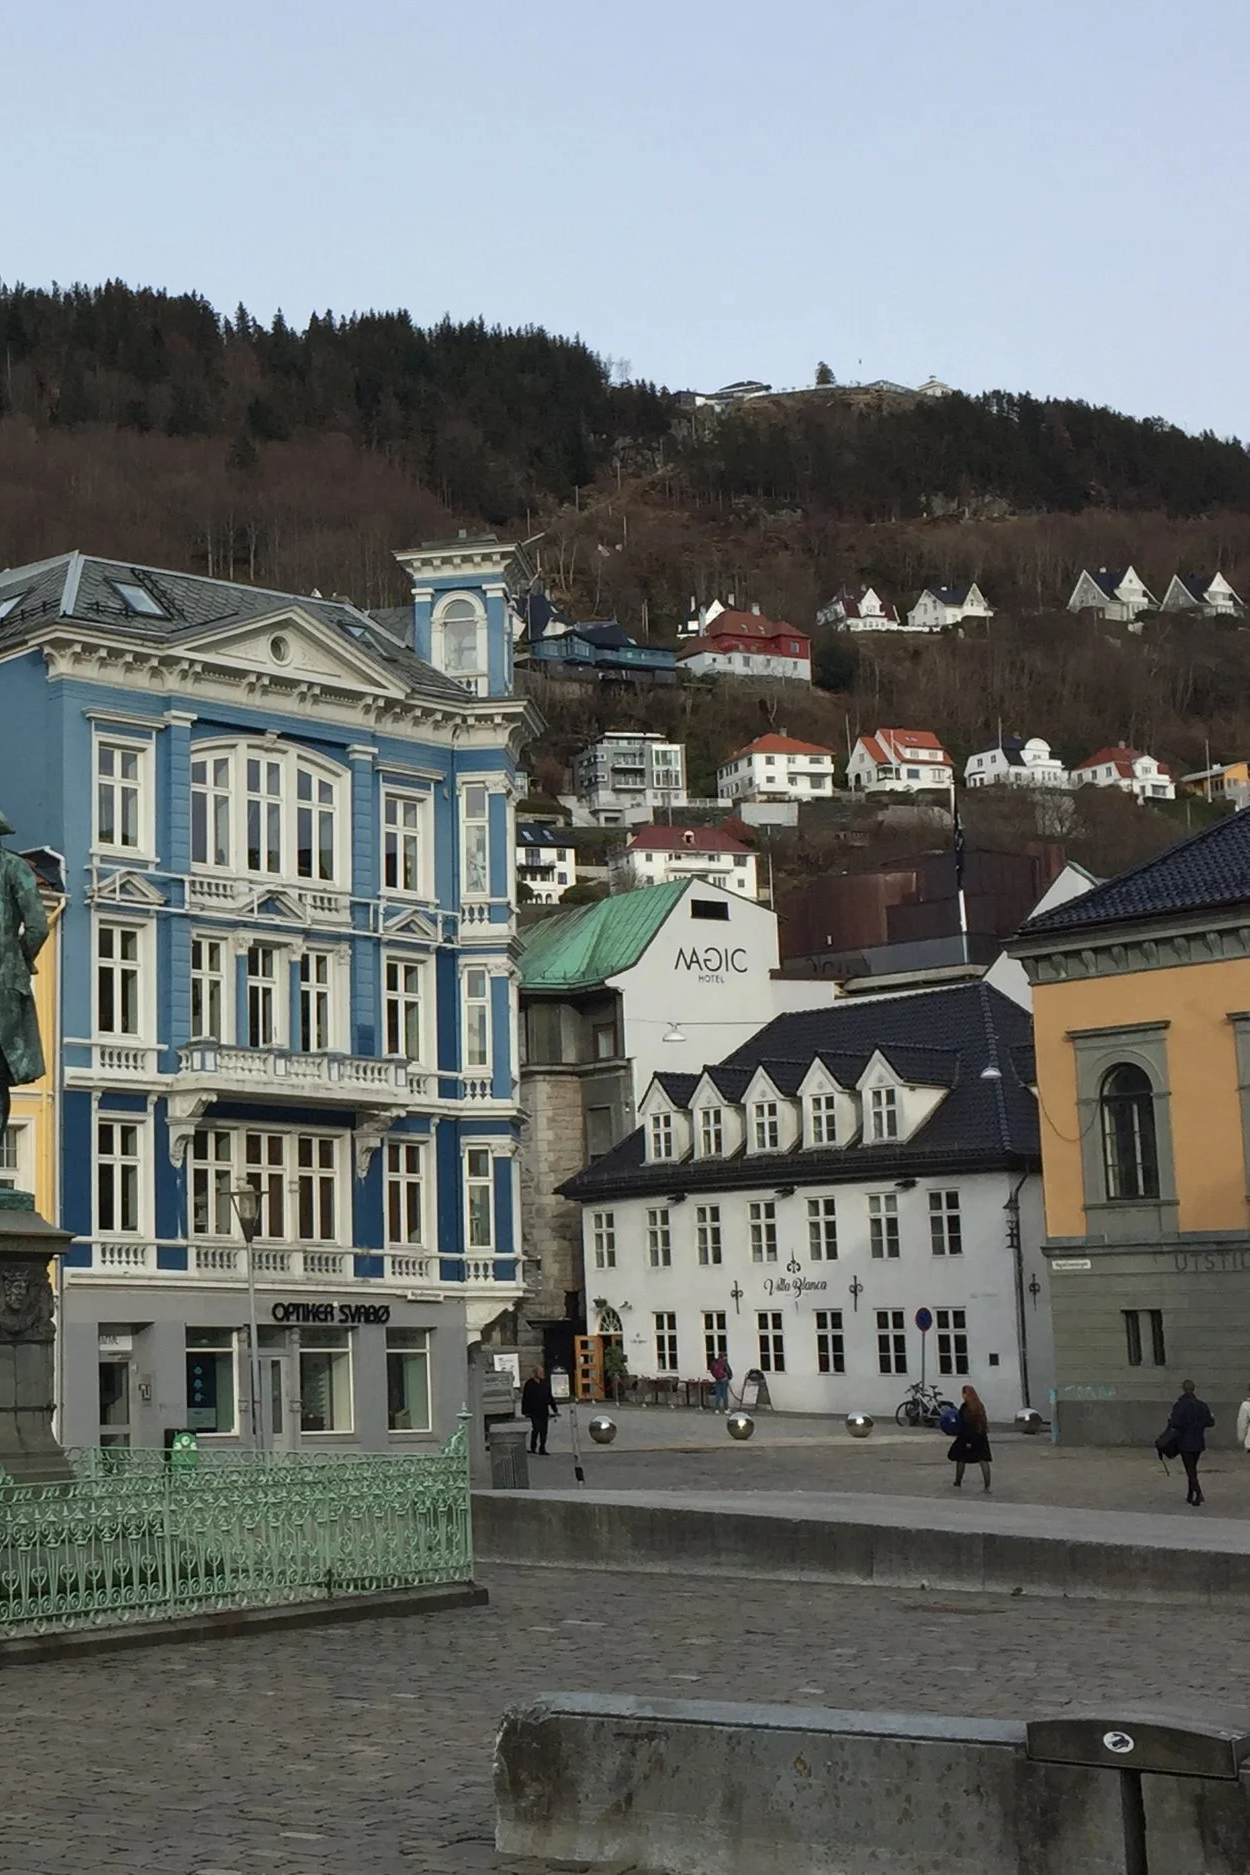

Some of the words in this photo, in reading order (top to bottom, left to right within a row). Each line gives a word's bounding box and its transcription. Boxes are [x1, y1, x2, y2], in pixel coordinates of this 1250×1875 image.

[674, 946, 748, 973] MAGIC
[698, 974, 725, 984] HOTEL
[763, 1278, 790, 1296] Villa
[792, 1276, 827, 1299] Blanca
[271, 1302, 335, 1323] OPTIKER
[338, 1303, 390, 1324] SVABØ
